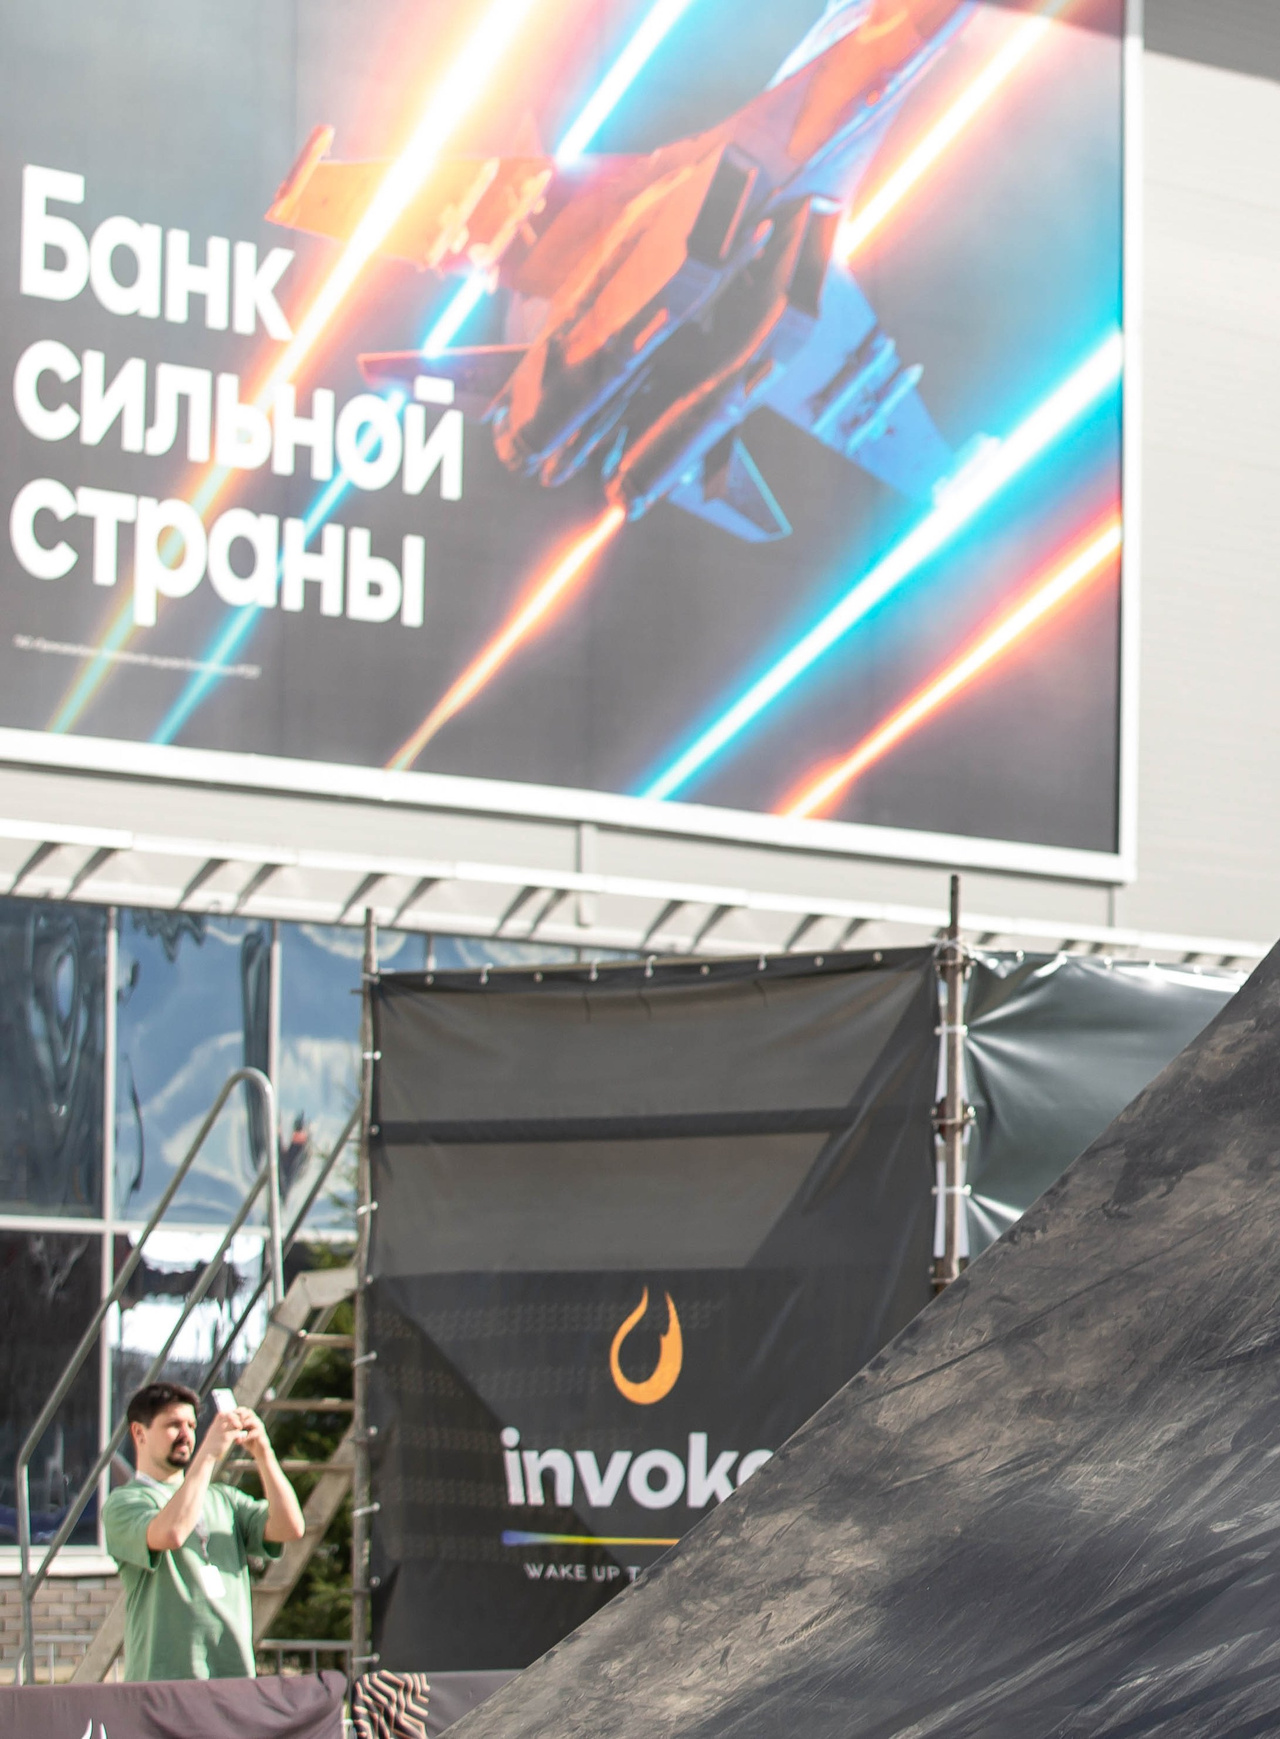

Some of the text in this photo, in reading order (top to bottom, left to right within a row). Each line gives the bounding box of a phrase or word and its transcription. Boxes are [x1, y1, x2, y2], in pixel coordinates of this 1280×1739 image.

[21, 164, 295, 341] Банк
[13, 340, 463, 501] сильной
[10, 478, 424, 627] страны
[523, 1562, 642, 1582] WAKE UP T
